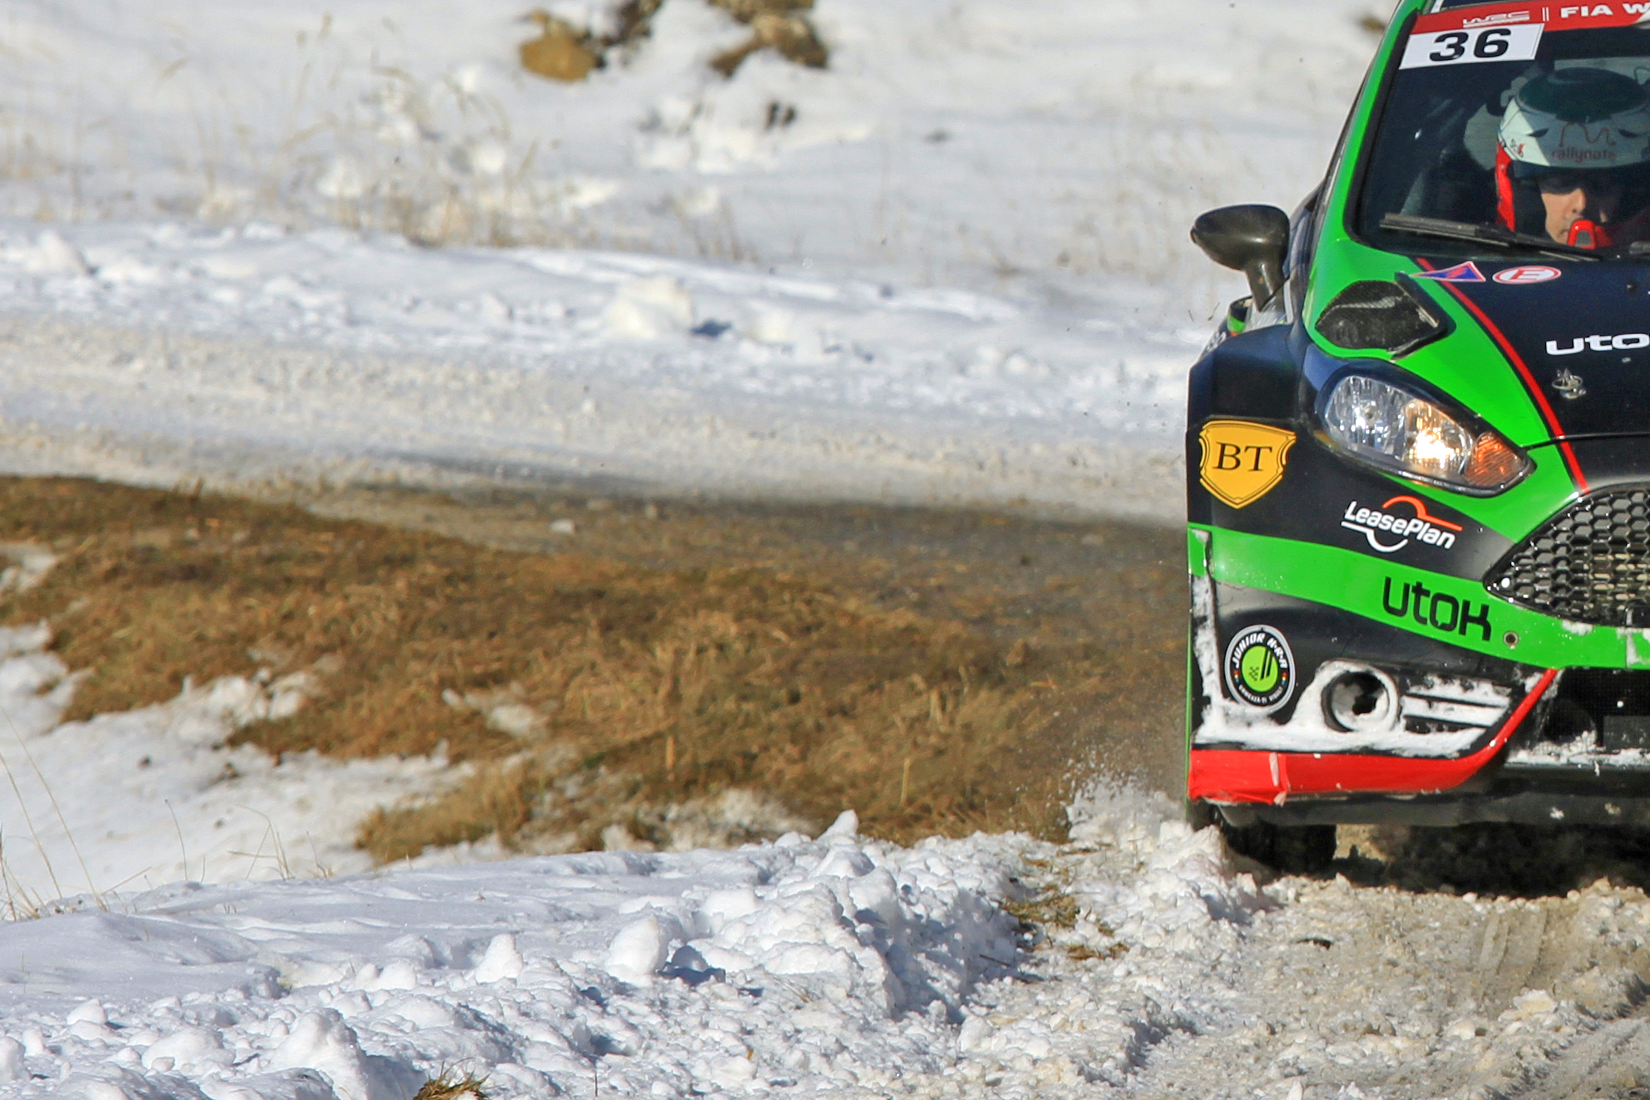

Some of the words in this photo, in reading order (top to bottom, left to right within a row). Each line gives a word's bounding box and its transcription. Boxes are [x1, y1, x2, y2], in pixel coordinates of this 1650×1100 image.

[1560, 5, 1613, 18] FIA
[1429, 28, 1511, 61] 36
[1212, 442, 1272, 472] BT
[1344, 501, 1456, 549] LeasePlan
[1232, 632, 1266, 669] JUNIOR
